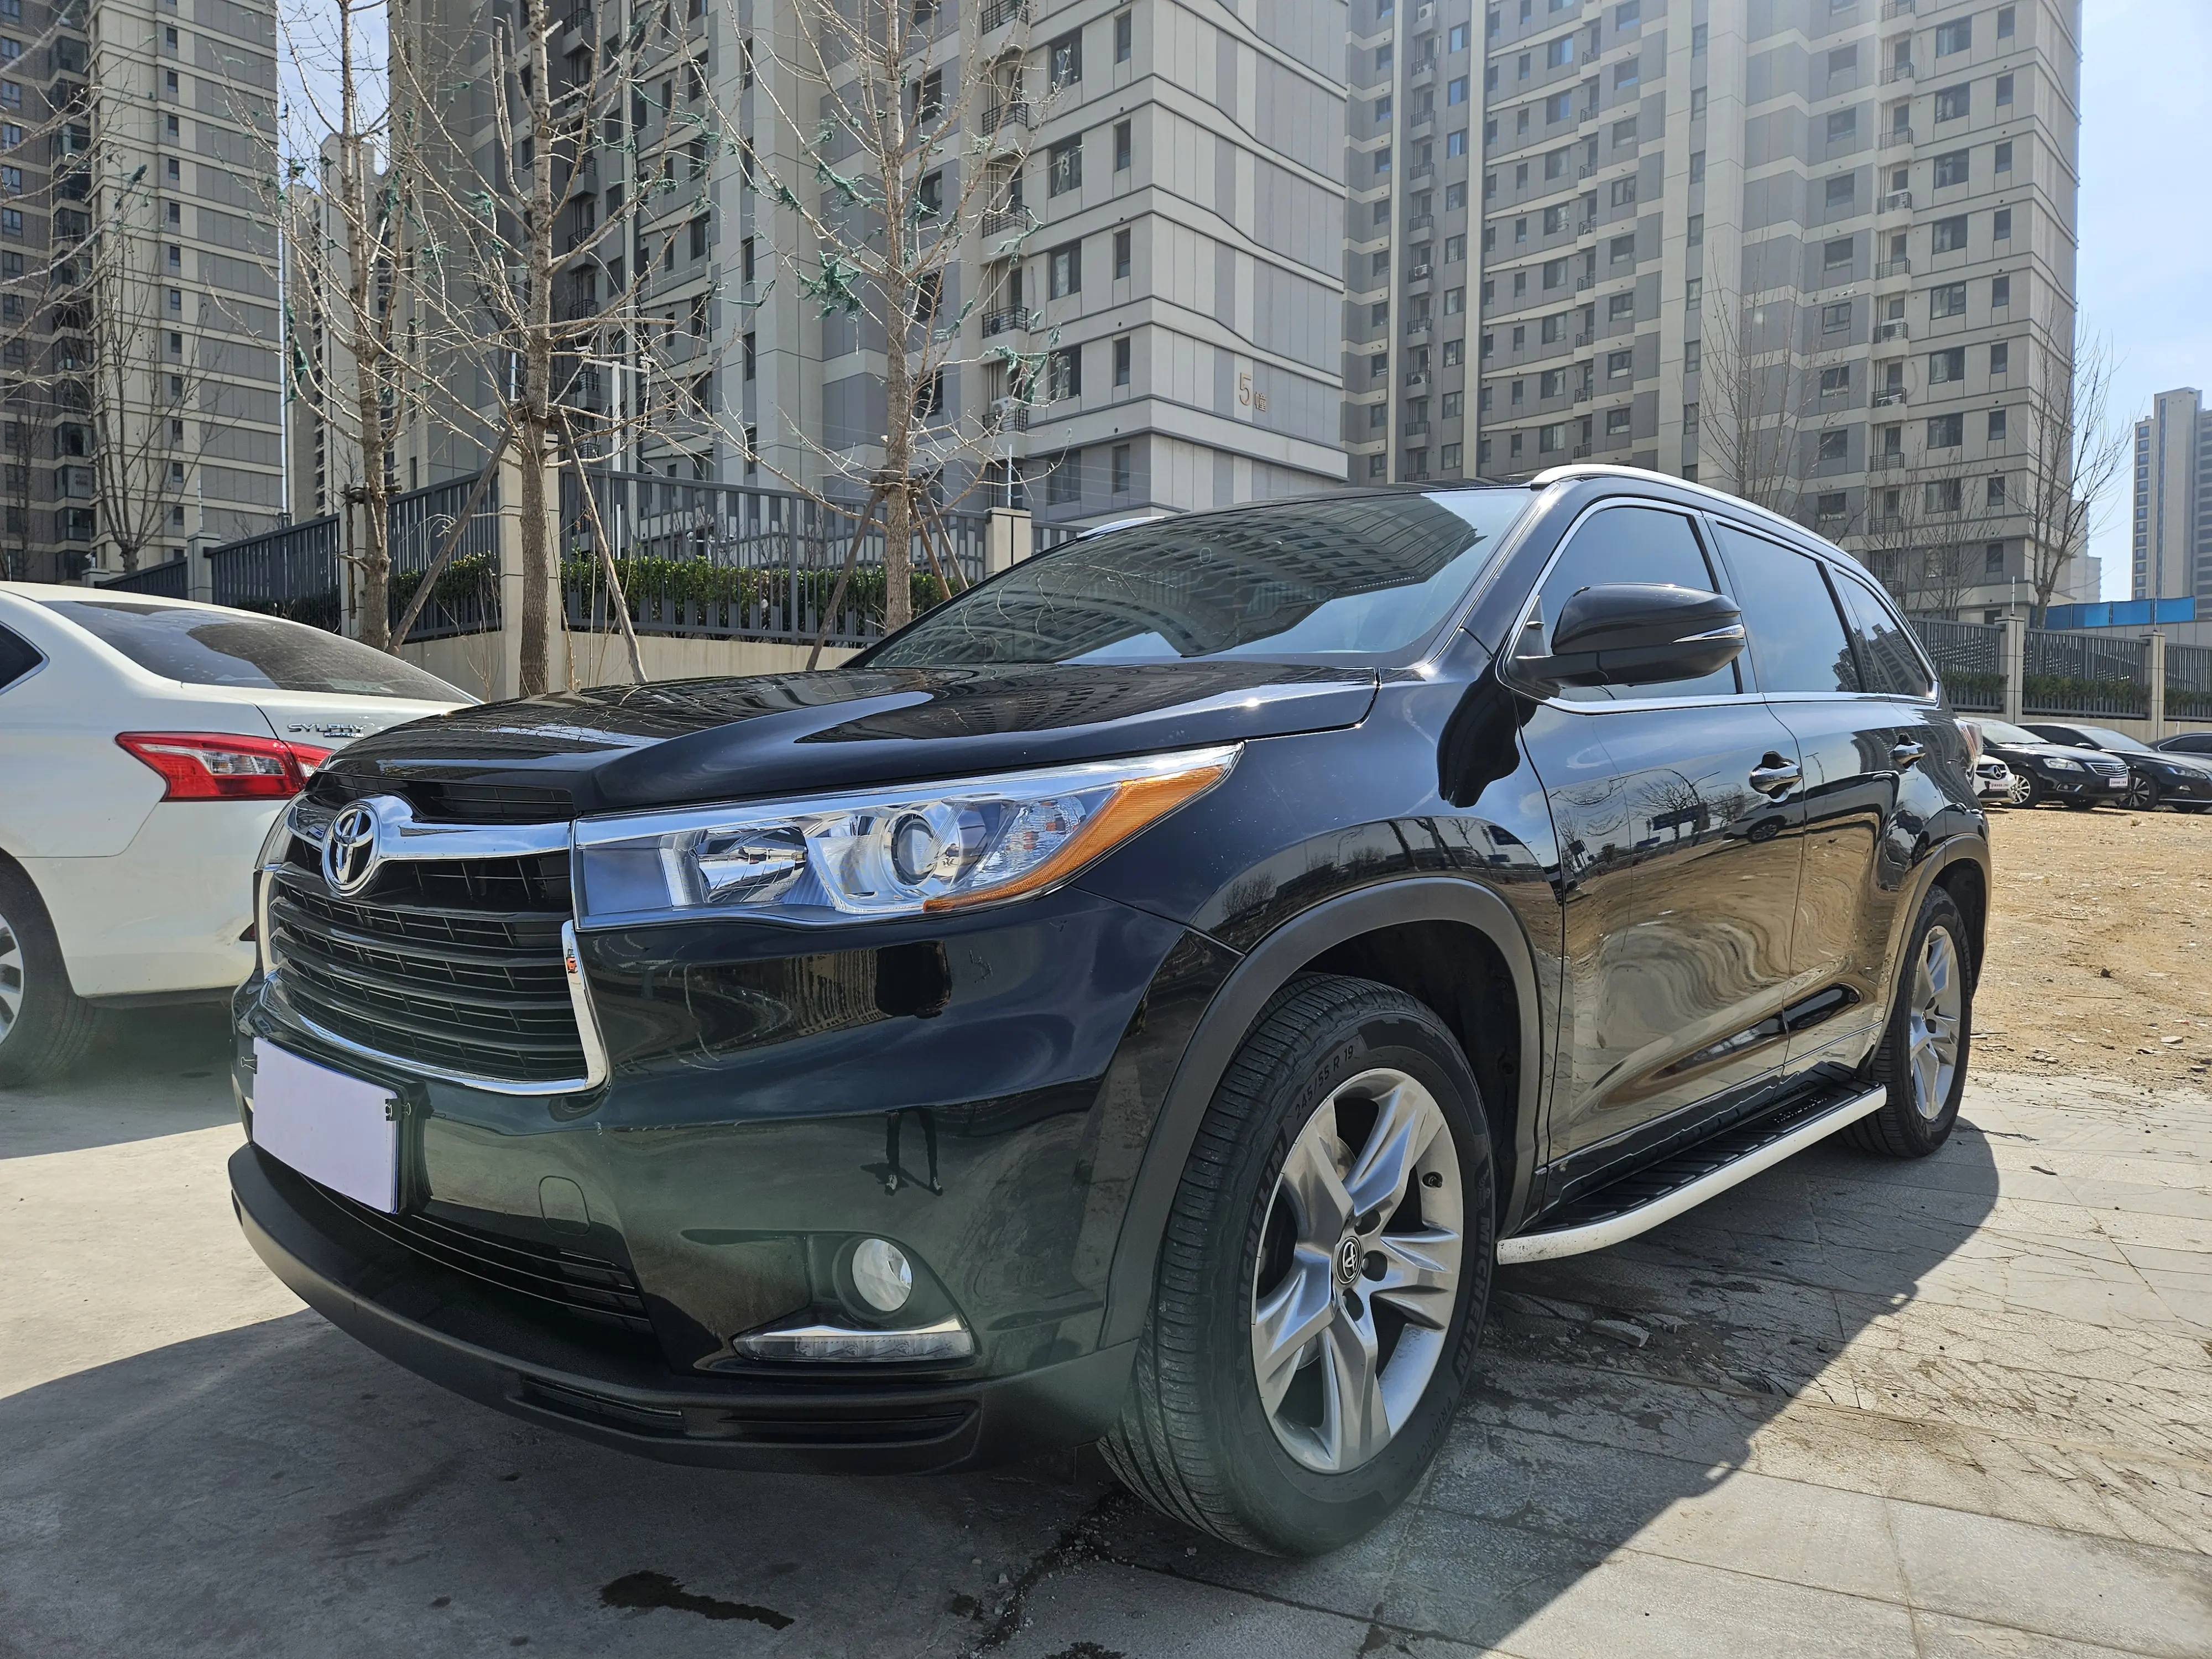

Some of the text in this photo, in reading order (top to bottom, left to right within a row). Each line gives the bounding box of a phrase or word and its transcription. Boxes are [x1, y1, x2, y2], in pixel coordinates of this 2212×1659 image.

[288, 723, 366, 733] SYLPHY
[1295, 1045, 1354, 1120] 245/55 R 19
[1238, 1139, 1284, 1332] MICHELIN
[1457, 1215, 1490, 1376] MICHELIN
